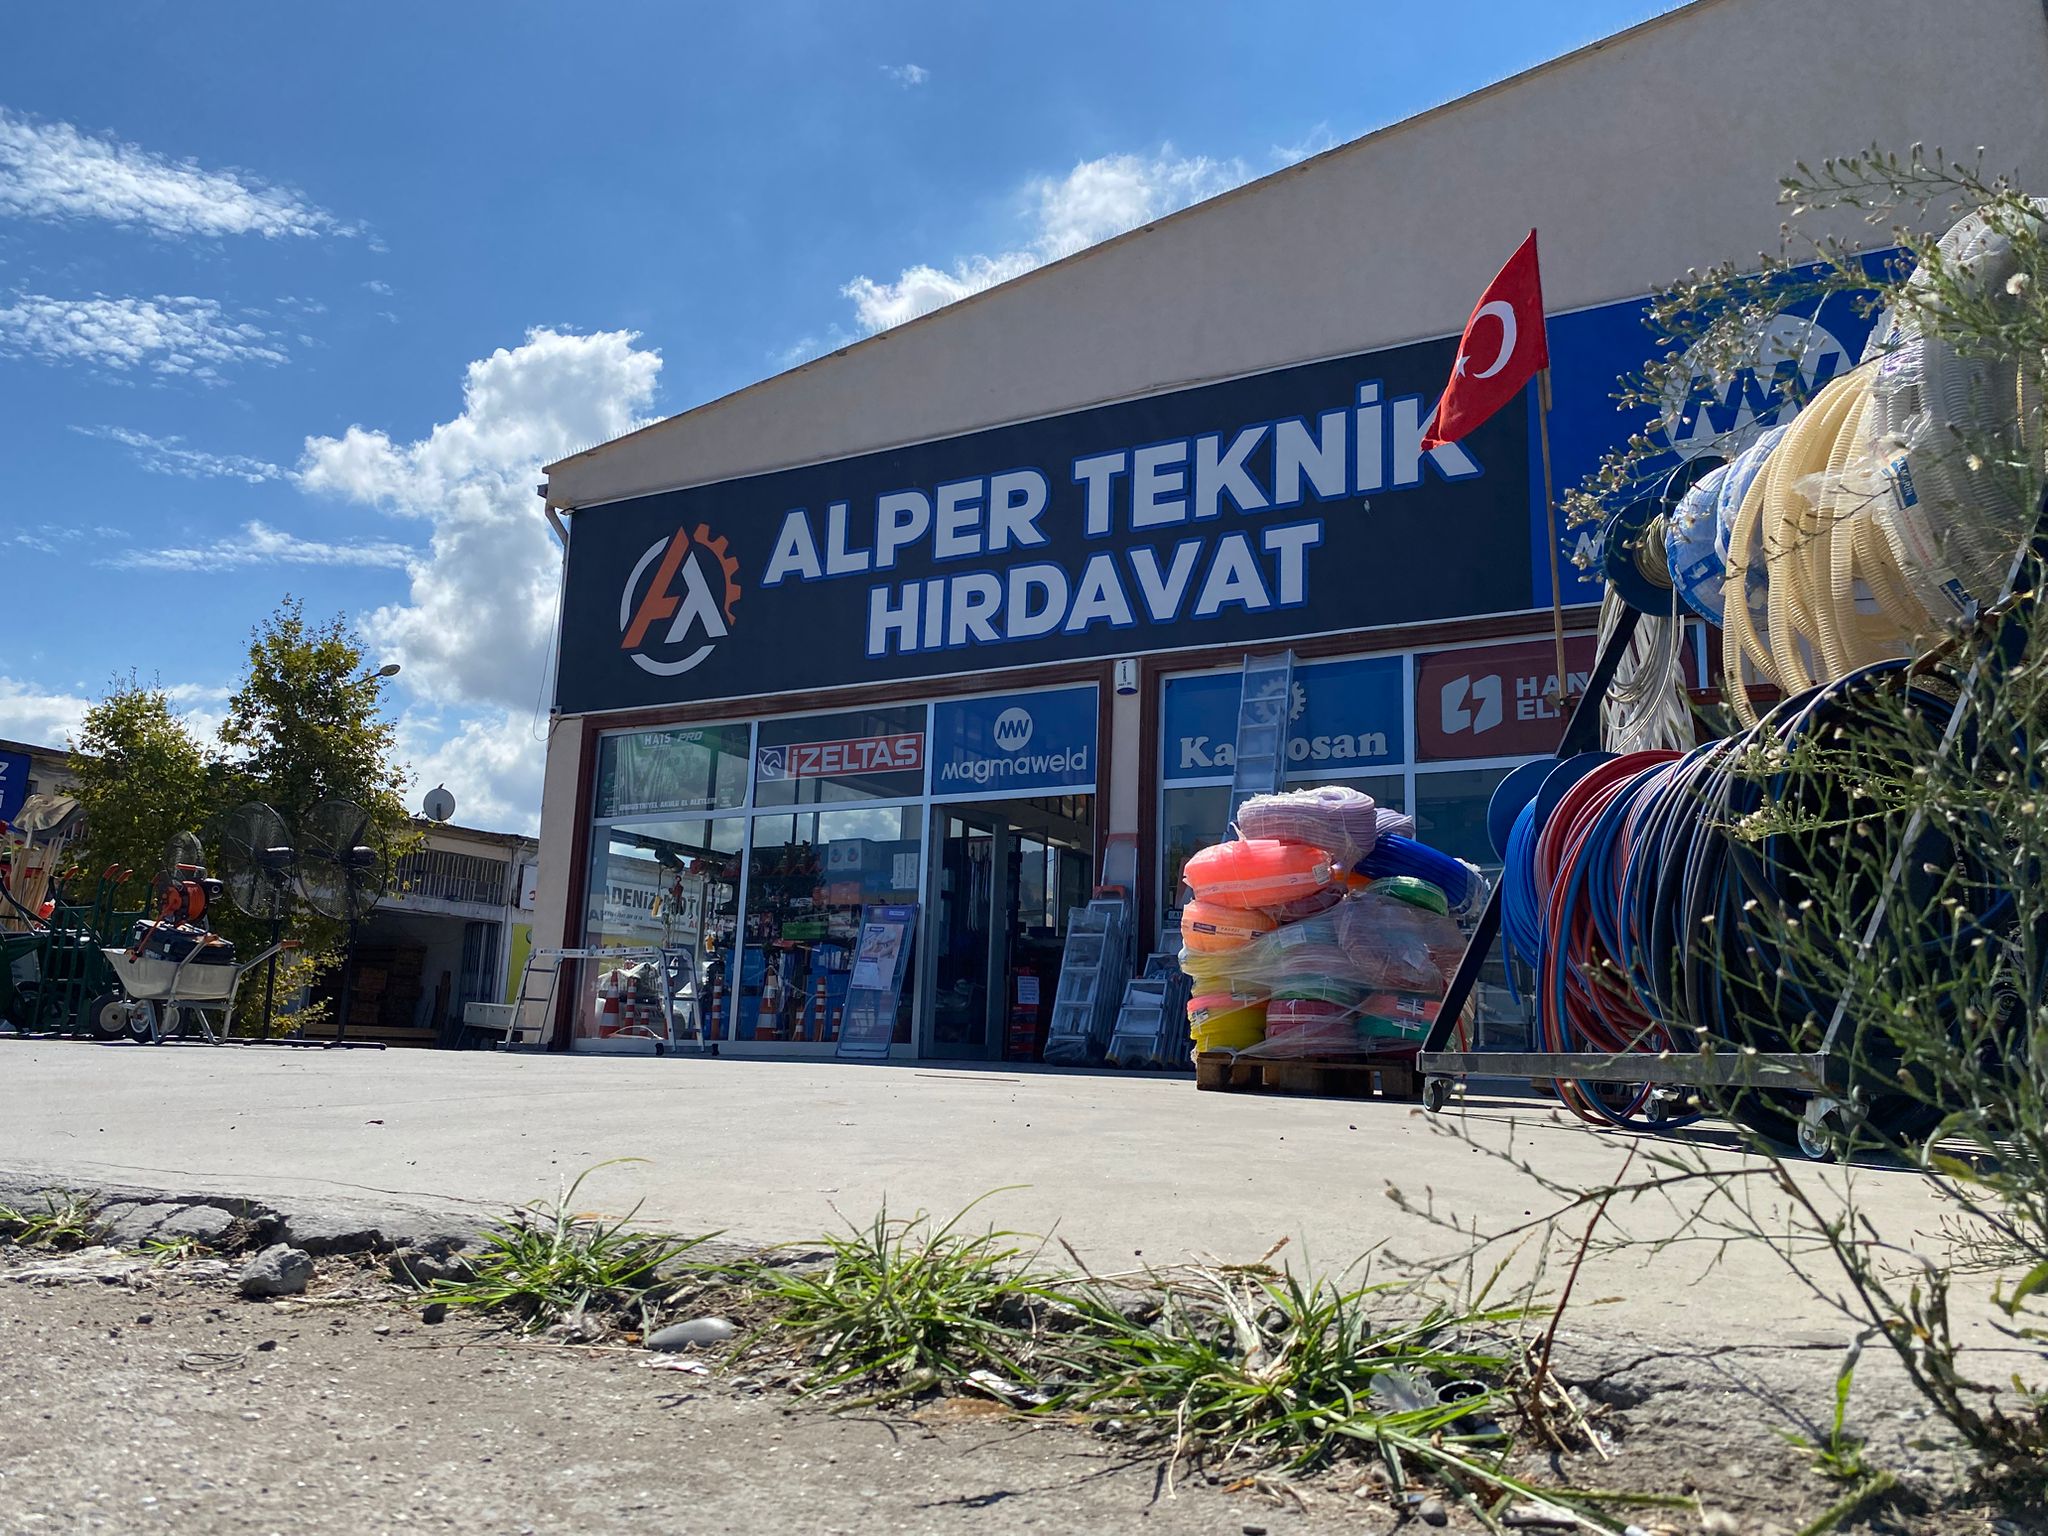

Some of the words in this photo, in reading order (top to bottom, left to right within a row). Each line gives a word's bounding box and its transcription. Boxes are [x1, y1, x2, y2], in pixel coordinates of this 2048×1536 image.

[761, 469, 1048, 585] ALPER
[1073, 382, 1480, 535] TEKNİK
[867, 522, 1320, 655] HIRDAVAT
[941, 745, 1088, 784] Magmaweld
[1179, 731, 1389, 769] Kaosan
